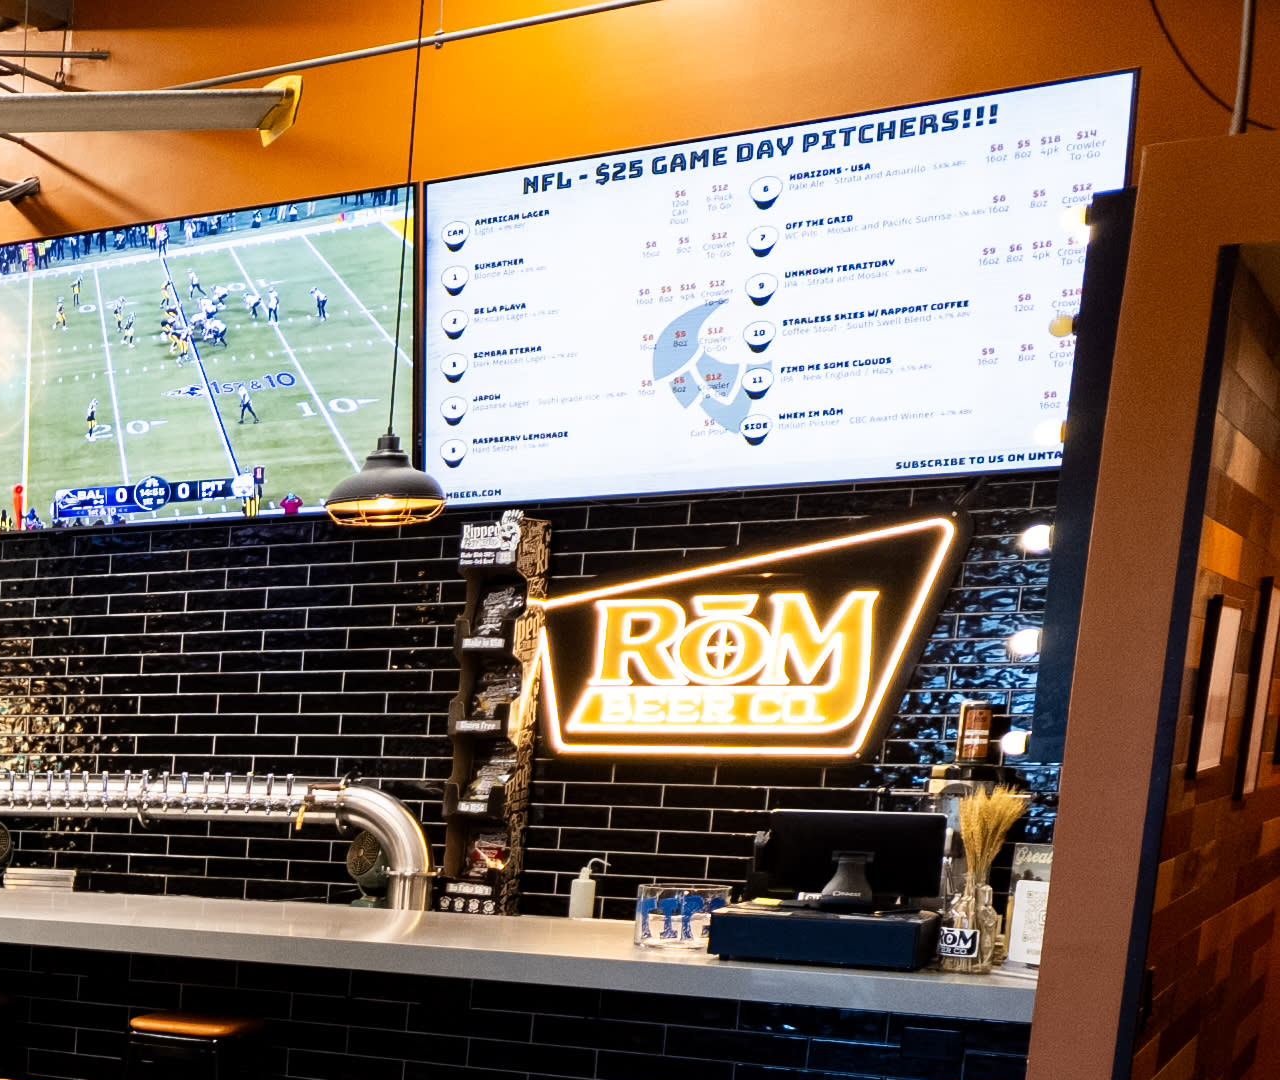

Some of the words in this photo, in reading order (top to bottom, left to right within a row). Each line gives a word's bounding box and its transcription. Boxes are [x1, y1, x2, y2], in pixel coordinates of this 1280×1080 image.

[1076, 129, 1097, 140] $14
[522, 172, 573, 195] NFL
[595, 157, 645, 187] $25
[651, 146, 727, 175] GAME
[736, 132, 794, 163] DAY
[801, 103, 1000, 153] PITCHERS!!!
[1017, 140, 1031, 149] $5
[1066, 139, 1106, 152] Crowler
[789, 167, 842, 181] HORIZONS
[851, 162, 871, 172] USA
[834, 174, 862, 185] Strata
[864, 169, 883, 179] and
[885, 164, 926, 177] Amarillo
[1033, 189, 1046, 198] $5
[1072, 182, 1093, 193] $12
[474, 213, 520, 226] AMERICAN
[521, 209, 550, 219] LAGER
[785, 221, 803, 230] OFF
[806, 218, 824, 227] THE
[827, 215, 853, 225] GRID
[827, 222, 859, 235] Mosaic
[861, 220, 880, 231] and
[882, 215, 912, 229] Pacific
[915, 211, 952, 224] Sunrise
[447, 228, 464, 237] CAN
[474, 258, 524, 271] SUNBATHER
[784, 266, 834, 279] UNKNOWN
[836, 258, 895, 272] TERRITORY
[807, 274, 835, 286] Strata
[837, 271, 854, 281] and
[857, 269, 890, 280] Mosaic
[474, 307, 485, 315] DE
[486, 306, 498, 314] LA
[499, 302, 527, 313] PLAYA
[782, 314, 832, 327] STARLESS
[834, 311, 865, 321] SKIES
[880, 304, 928, 316] RAPPORT
[930, 299, 970, 311] COFFEE
[782, 326, 811, 337] Coffee
[847, 320, 874, 331] South
[876, 316, 902, 328] Swell
[904, 312, 932, 324] Blend
[753, 329, 766, 337] 10
[473, 349, 507, 359] SOMBRA
[509, 346, 542, 355] ETERNA
[780, 365, 805, 374] FIND
[808, 363, 821, 372] ME
[823, 361, 850, 370] SOME
[852, 356, 892, 367] CLOUDS
[264, 372, 296, 388] 10
[803, 371, 822, 382] New
[825, 368, 861, 381] England
[872, 366, 894, 377] Hazy
[473, 394, 501, 402] JAPOW
[779, 411, 805, 420] WHEN
[807, 409, 821, 418] IN
[849, 416, 868, 425] CBC
[869, 413, 898, 423] Award
[900, 411, 934, 421] Winner
[744, 422, 768, 430] SIDE
[472, 435, 521, 444] RASPBERRY
[523, 431, 569, 441] LEMONADE
[895, 457, 966, 470] SUBSCRIBE
[969, 456, 985, 465] TO
[989, 454, 1004, 463] US
[1008, 453, 1025, 462] ON
[177, 483, 190, 499] 0
[201, 480, 226, 491] PIT
[77, 489, 105, 500] BAL
[115, 488, 128, 502] 0
[463, 521, 501, 539] Ripped
[600, 692, 736, 723] BEER
